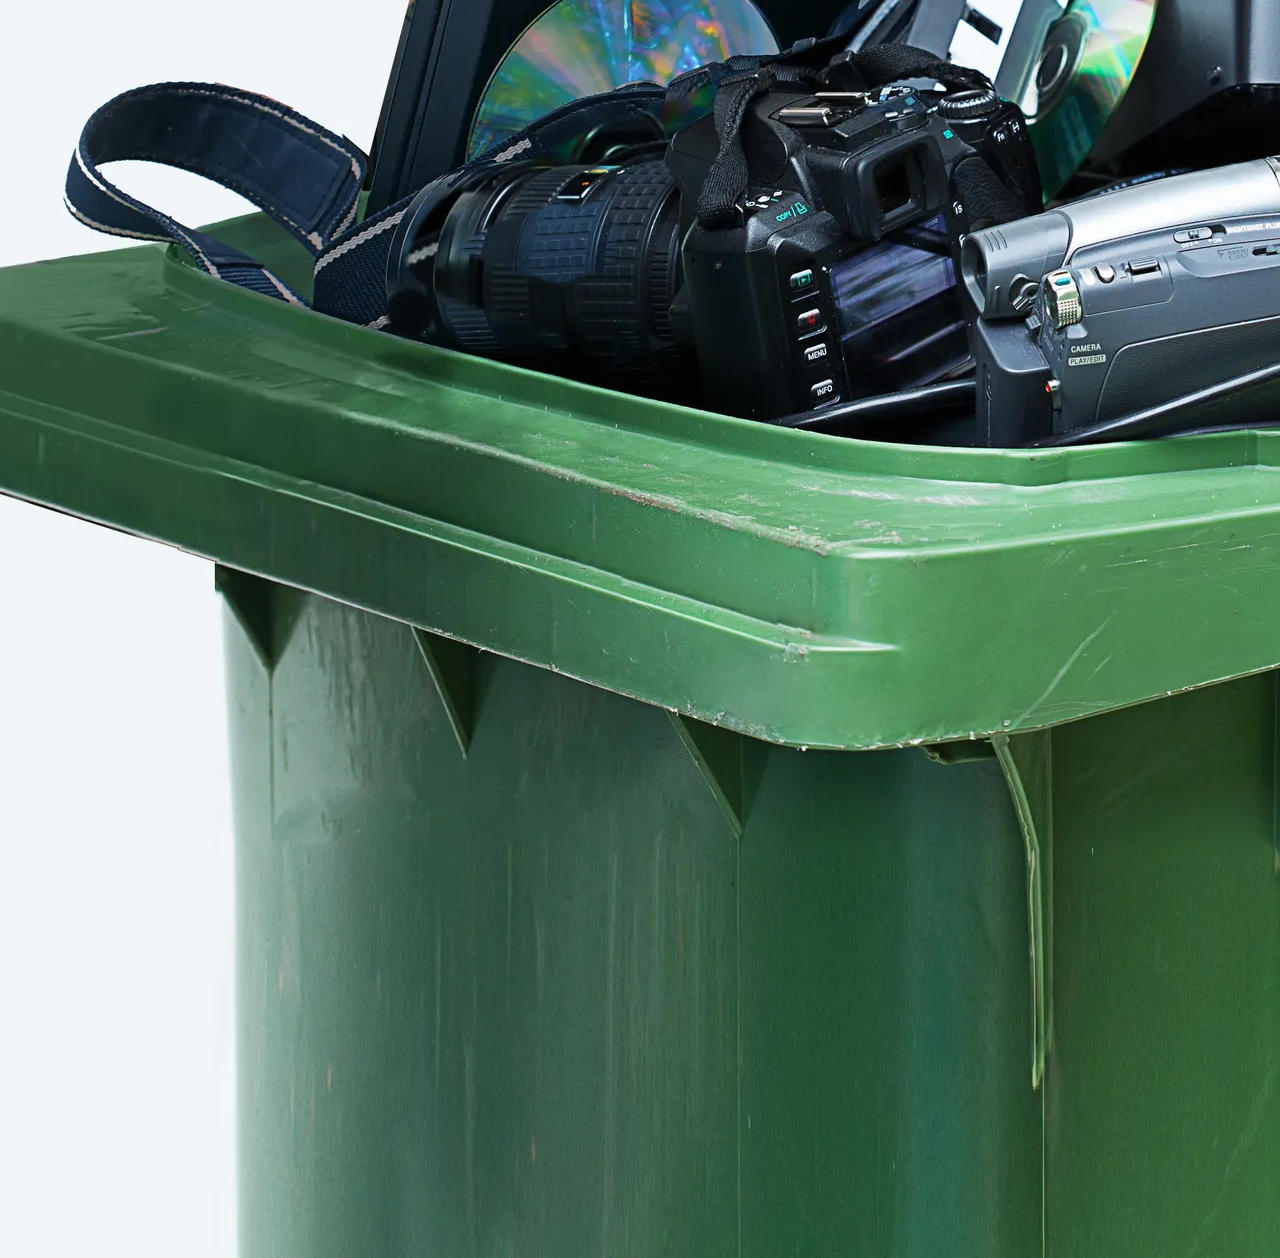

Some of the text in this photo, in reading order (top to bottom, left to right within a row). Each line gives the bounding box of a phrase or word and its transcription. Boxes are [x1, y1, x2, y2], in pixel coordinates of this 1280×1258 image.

[1071, 344, 1101, 353] CAMERA
[807, 348, 827, 361] MENU
[1070, 355, 1105, 365] PLAY/EDIT
[816, 384, 833, 397] INFO
